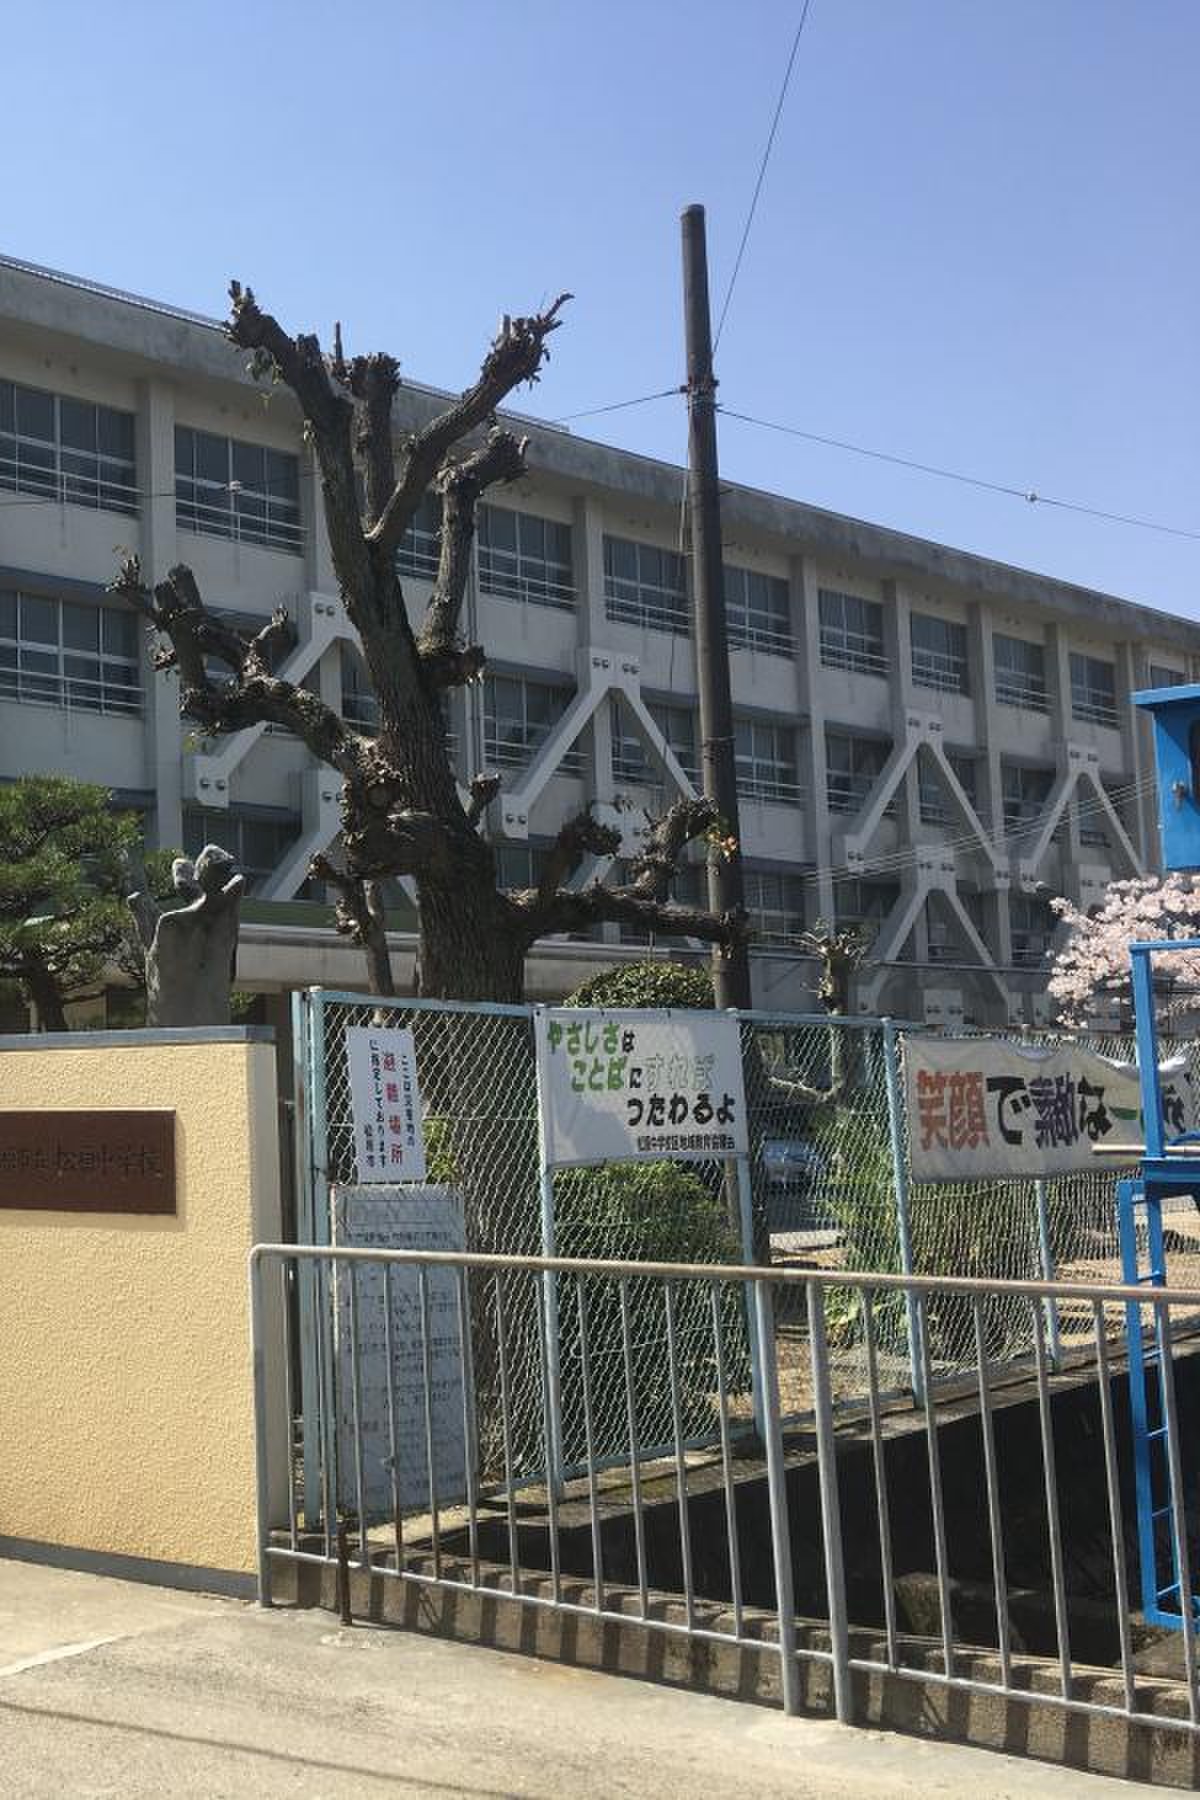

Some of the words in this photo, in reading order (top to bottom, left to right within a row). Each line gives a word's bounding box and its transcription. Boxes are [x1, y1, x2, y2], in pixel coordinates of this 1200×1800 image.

[547, 1020, 635, 1056] やさしさは
[626, 1093, 736, 1127] つたわるよ
